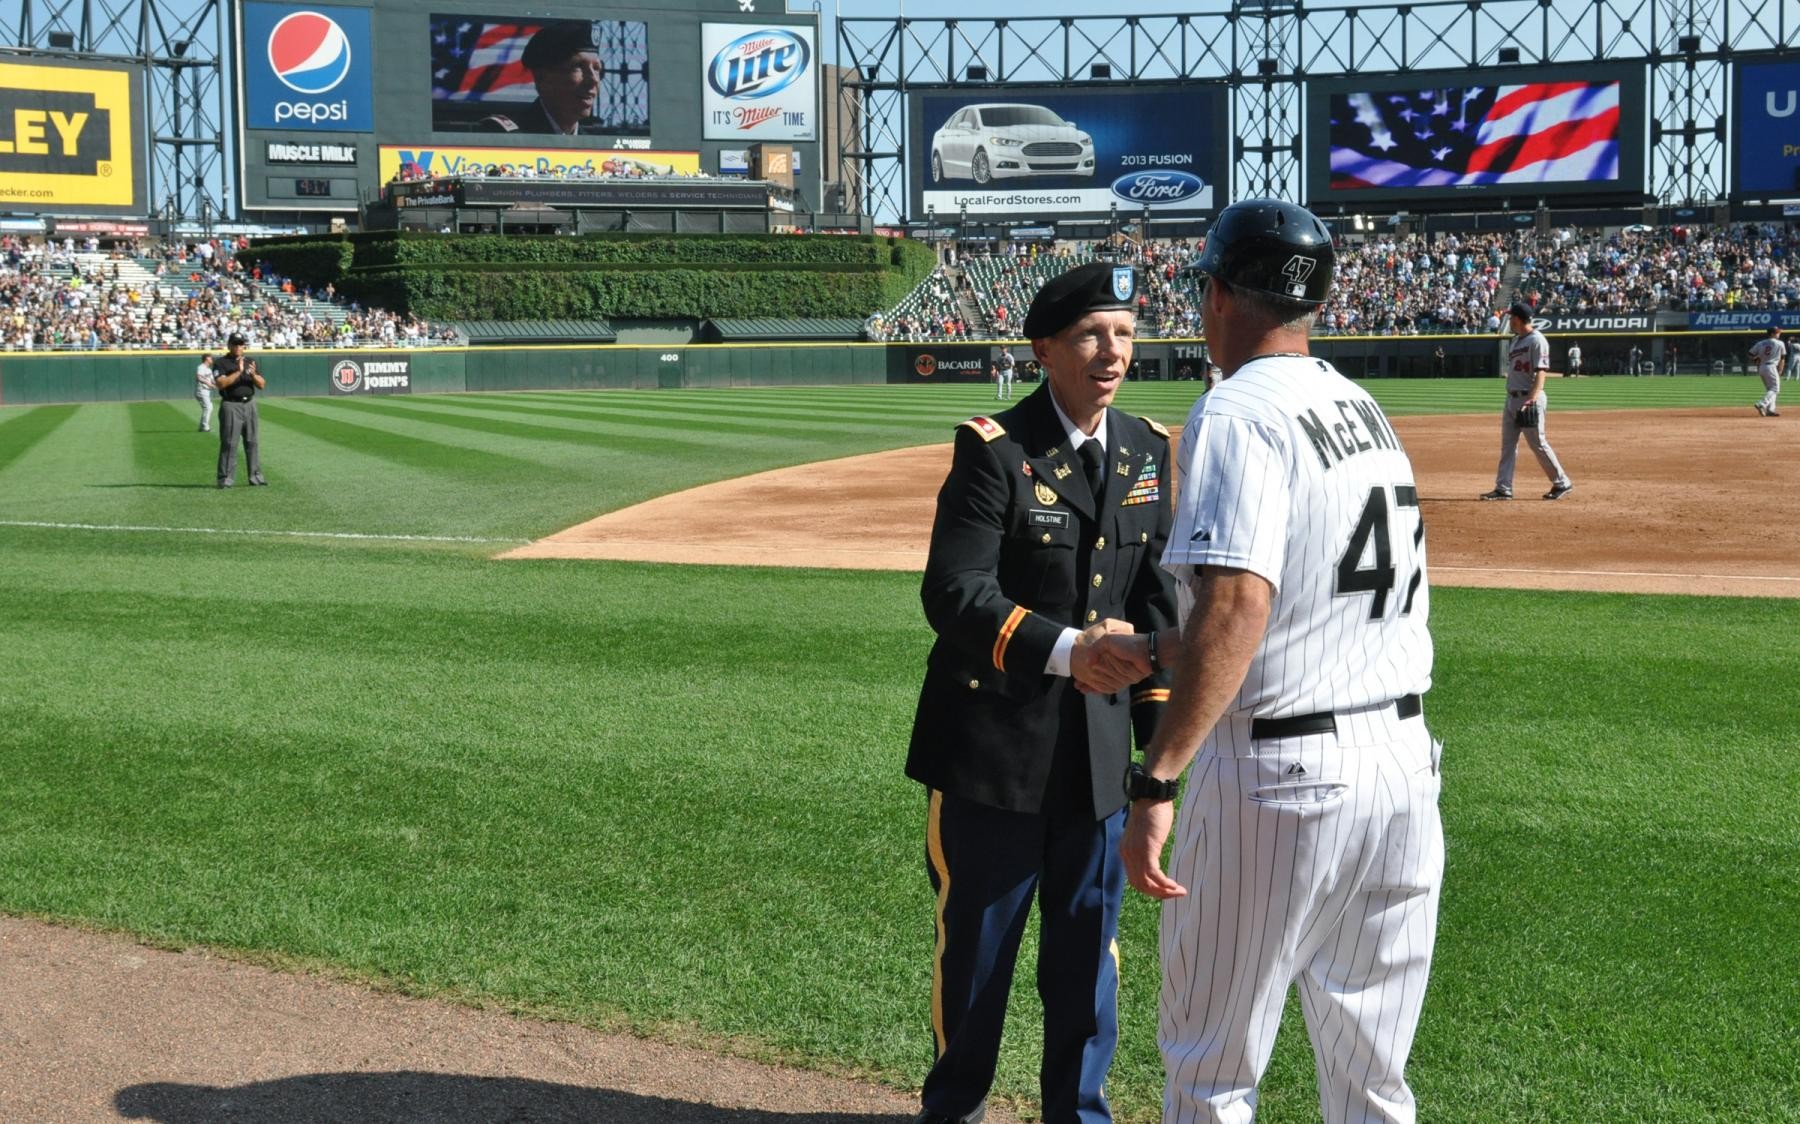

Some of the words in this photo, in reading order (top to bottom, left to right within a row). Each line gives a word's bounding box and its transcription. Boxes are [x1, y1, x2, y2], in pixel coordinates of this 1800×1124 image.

[739, 39, 775, 56] Miller
[724, 43, 796, 98] Lite
[274, 100, 347, 123] pepsi
[713, 110, 731, 125] IT'S
[733, 106, 782, 130] Miller
[783, 111, 805, 126] TIME
[268, 144, 320, 161] MUSCLE
[321, 146, 356, 162] MILK
[1121, 155, 1147, 166] 2013
[1148, 154, 1193, 166] FUSION
[1129, 175, 1185, 198] Ford
[669, 192, 706, 200] SERVICE
[954, 195, 1082, 205] LocalFordStores.com
[1281, 254, 1317, 284] 47
[1557, 317, 1648, 329] HYUNDAI
[1695, 313, 1772, 326] ATHLETICO
[660, 354, 679, 362] 400
[363, 362, 408, 376] JIMMY
[364, 376, 409, 391] JOHN'S
[1296, 399, 1403, 470] McEWI
[1035, 514, 1062, 524] HOLSTINE
[1333, 483, 1425, 624] 47
